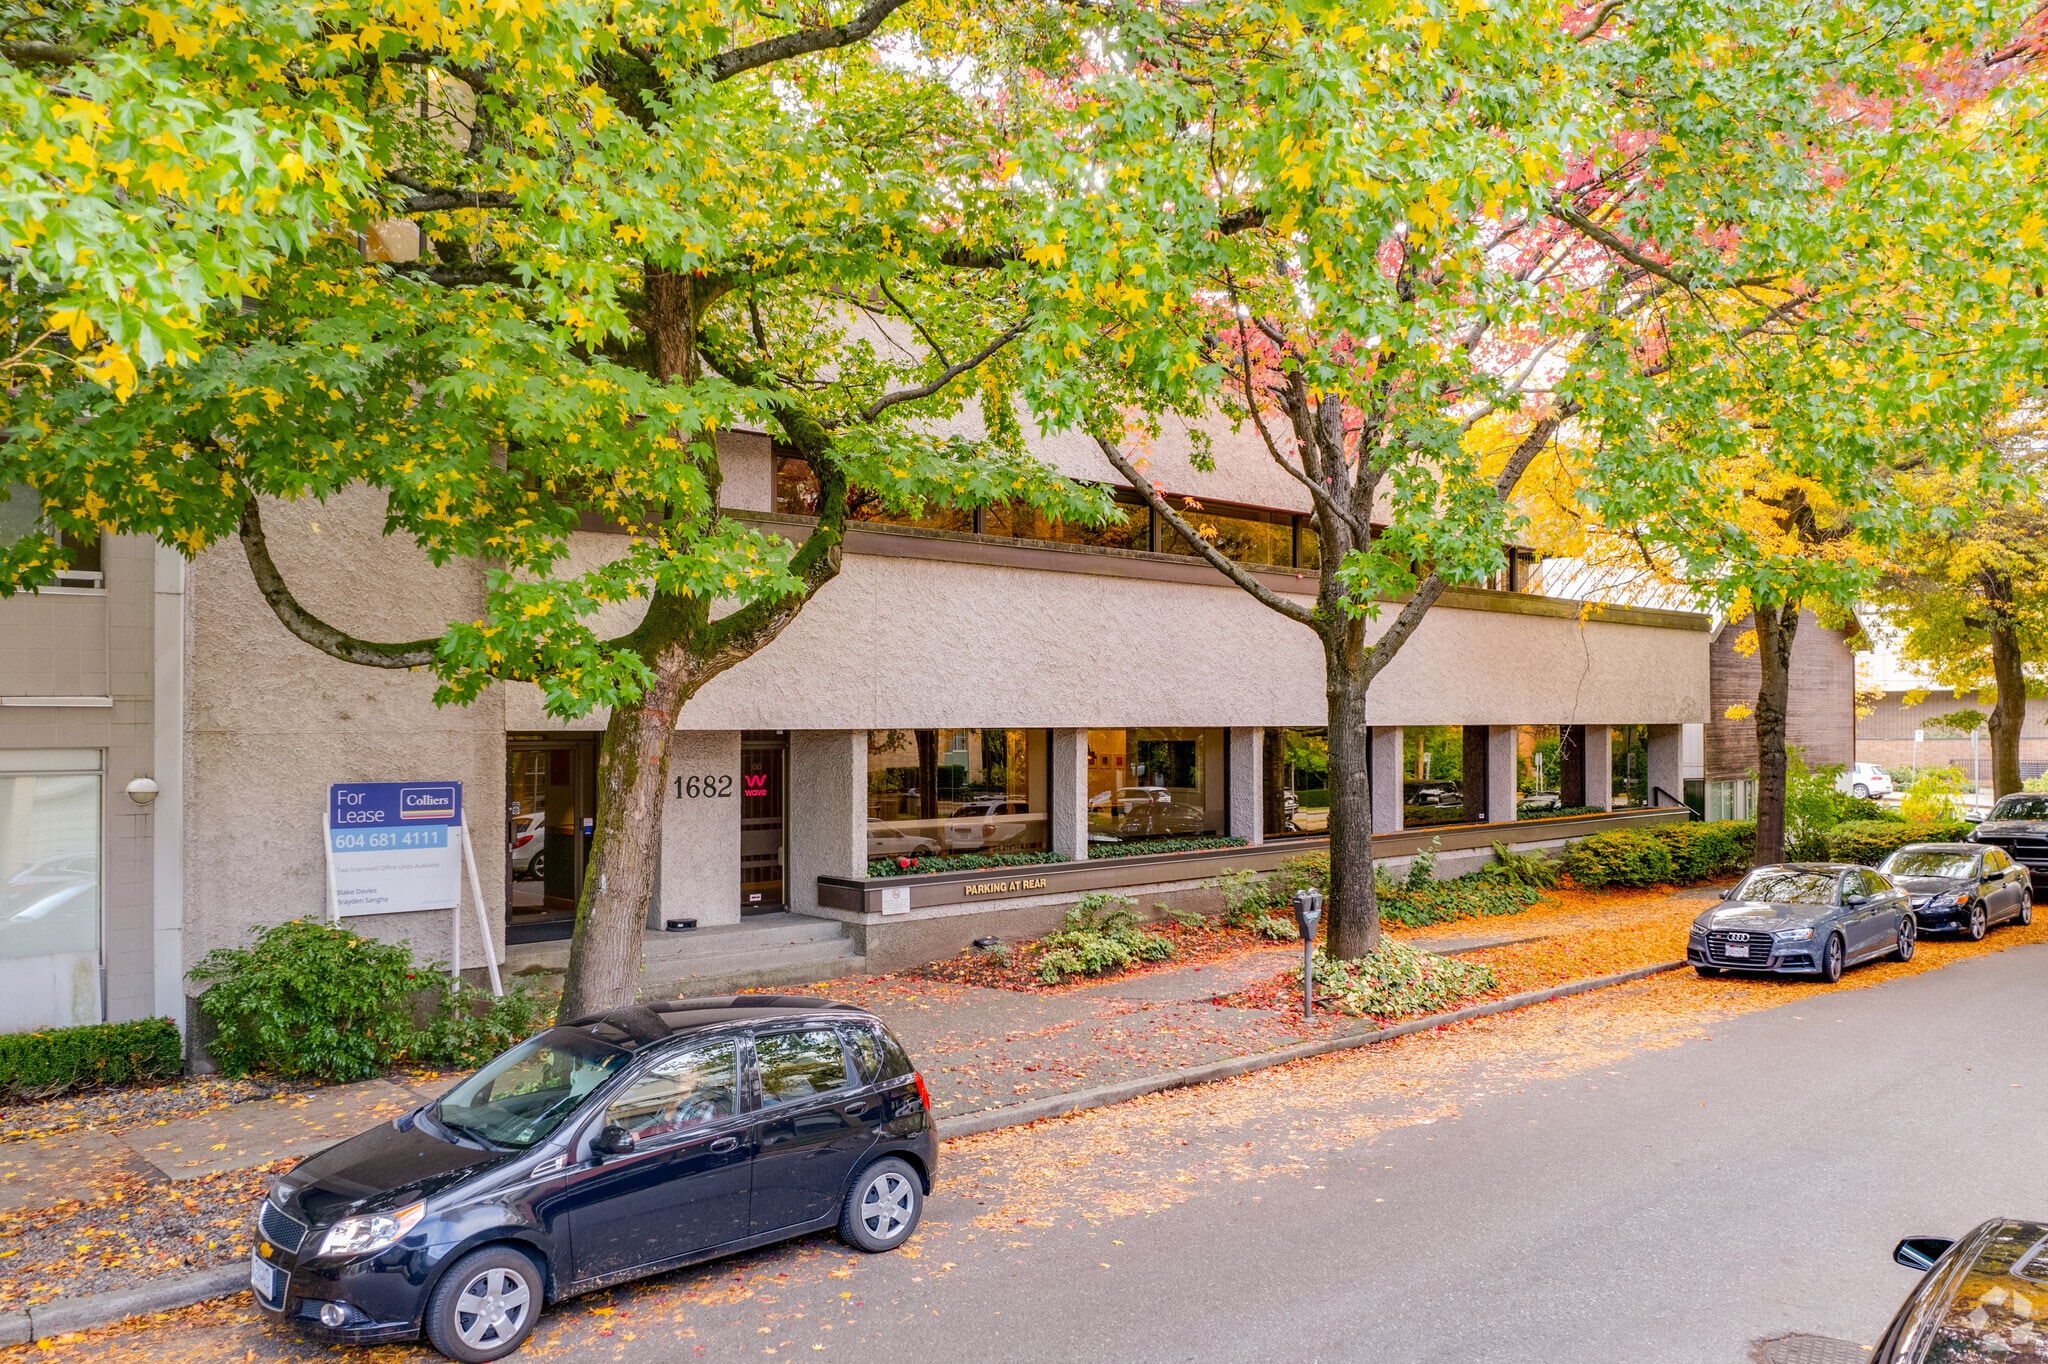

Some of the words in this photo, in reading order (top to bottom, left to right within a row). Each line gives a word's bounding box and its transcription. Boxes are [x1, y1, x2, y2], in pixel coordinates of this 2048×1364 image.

[673, 775, 733, 799] 1682
[744, 789, 767, 797] wave
[337, 790, 366, 806] For
[406, 794, 449, 806] Colliers
[337, 808, 385, 824] Lease
[336, 834, 365, 849] 604
[369, 833, 397, 847] 681
[402, 831, 439, 846] 4111
[351, 865, 379, 874] Improved
[965, 882, 1007, 896] PARKING
[1009, 880, 1021, 891] AT
[1022, 878, 1047, 890] REAR
[365, 896, 389, 904] Sangha
